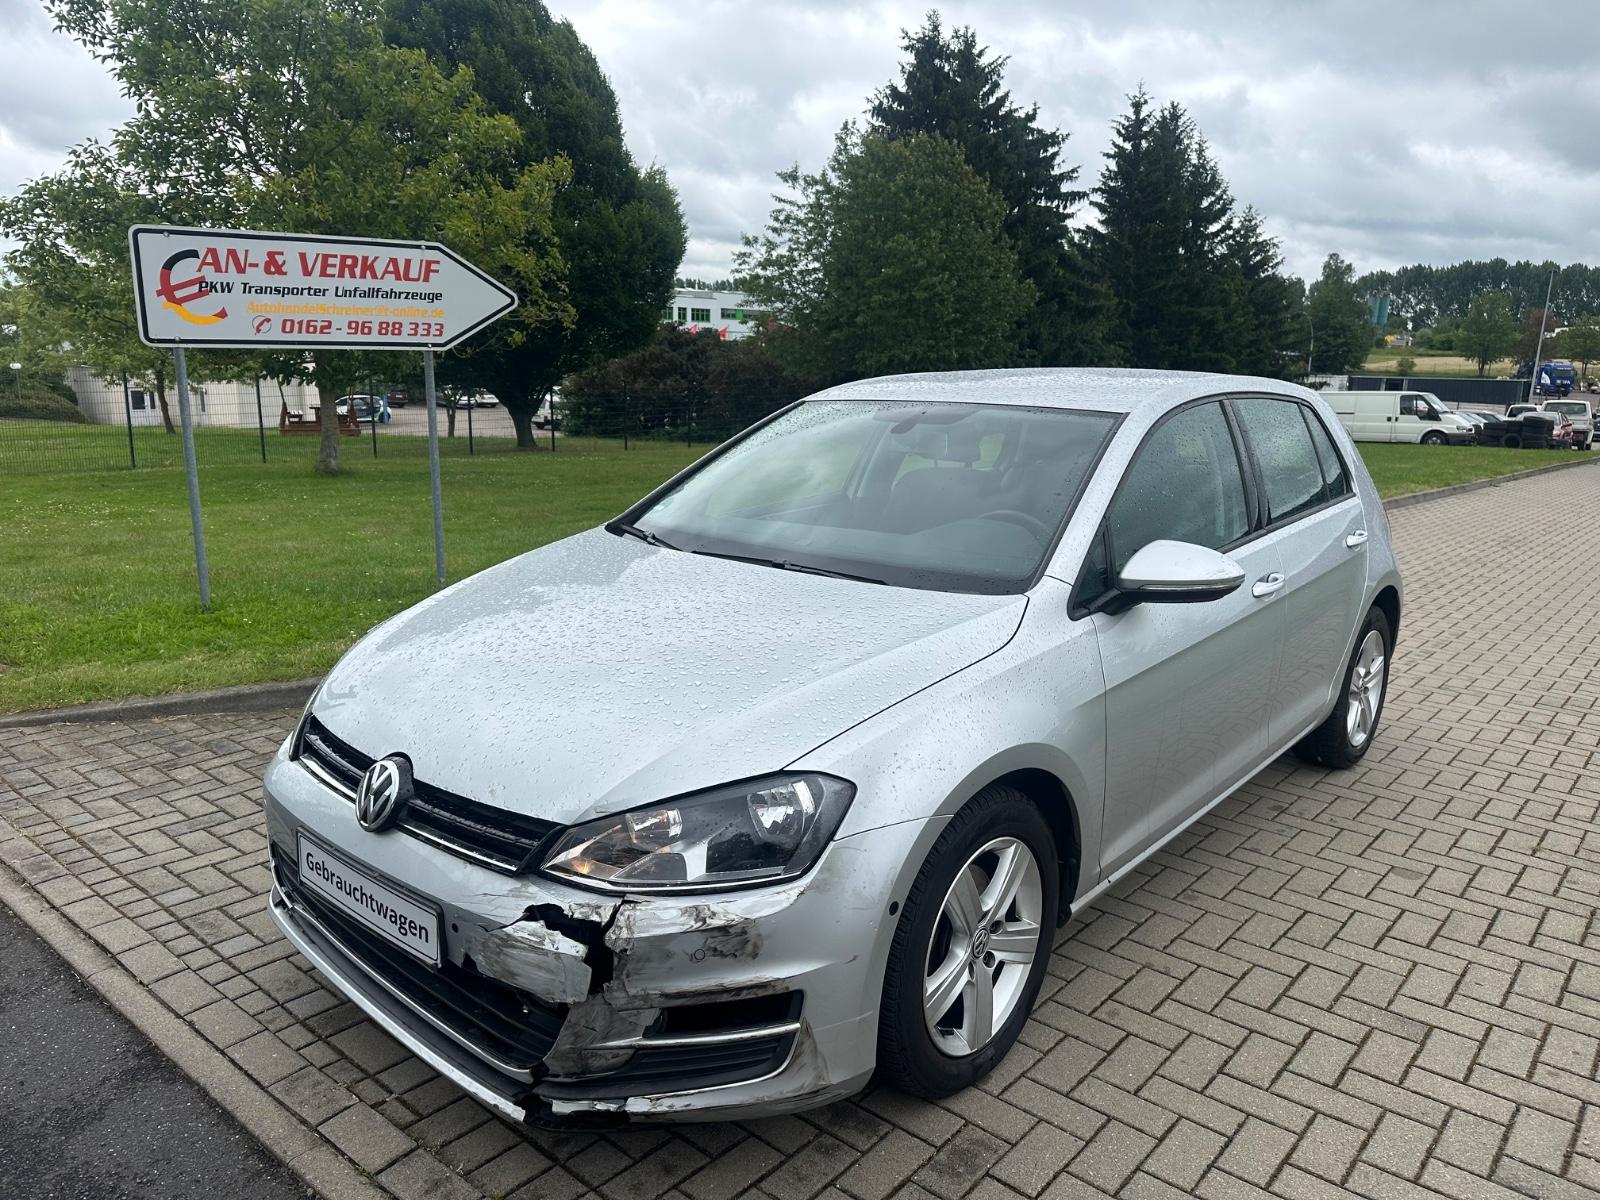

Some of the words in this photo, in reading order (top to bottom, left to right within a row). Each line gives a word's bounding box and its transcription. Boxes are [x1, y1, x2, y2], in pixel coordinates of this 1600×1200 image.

[196, 247, 259, 274] AN-
[263, 250, 288, 276] &
[297, 251, 441, 283] VERKAUF
[198, 281, 235, 294] PKW
[240, 282, 329, 298] Transporter
[334, 286, 443, 303] Unfallfahrzeuge
[406, 321, 445, 338] 333
[305, 851, 430, 944] Gebrauchtwagen
